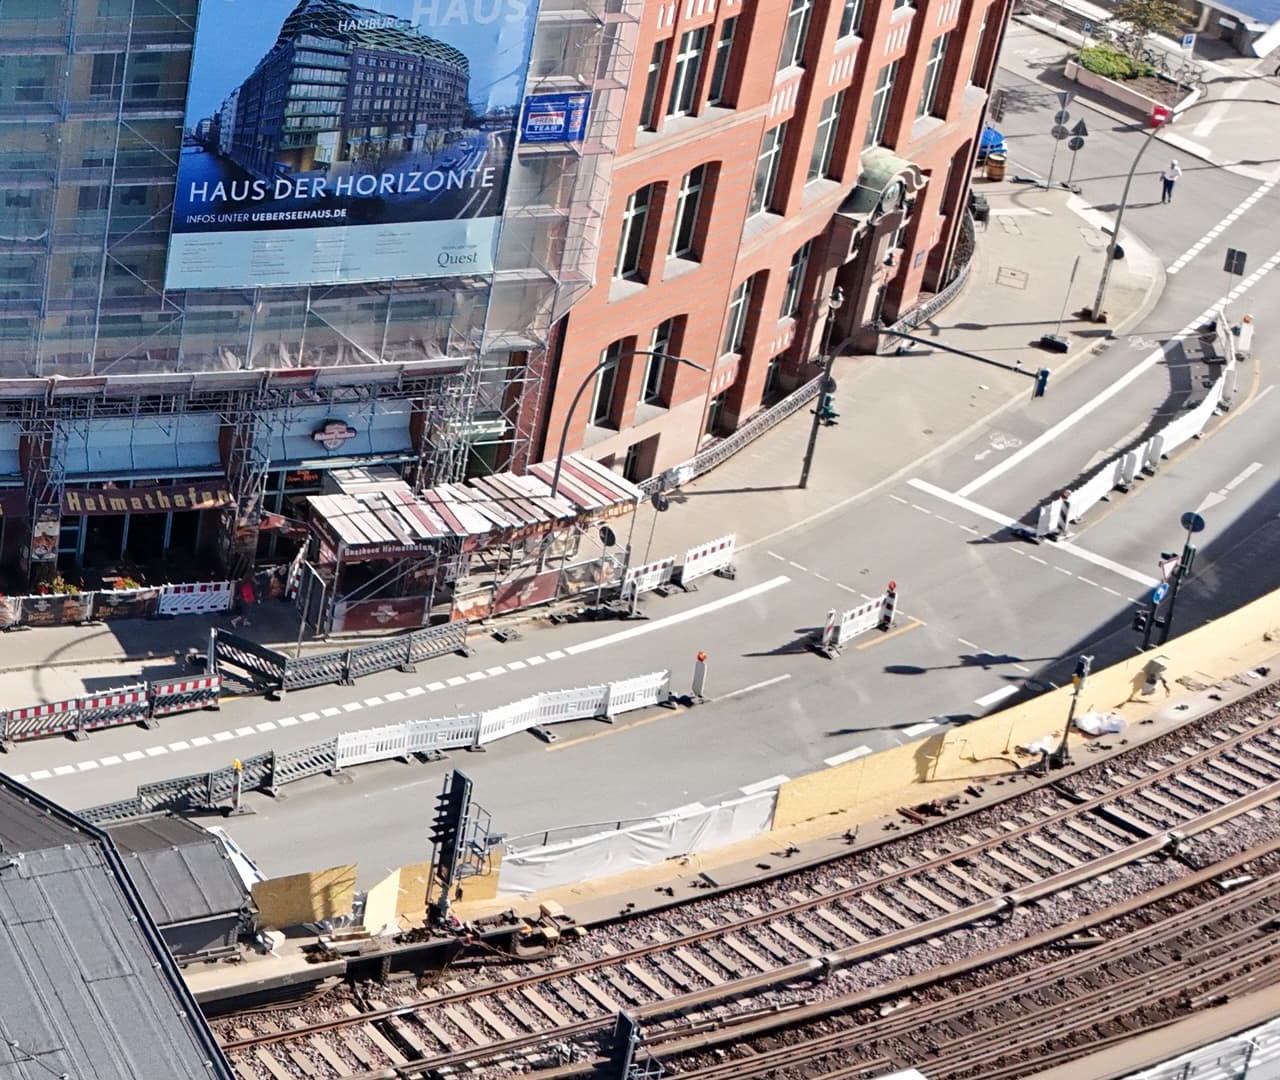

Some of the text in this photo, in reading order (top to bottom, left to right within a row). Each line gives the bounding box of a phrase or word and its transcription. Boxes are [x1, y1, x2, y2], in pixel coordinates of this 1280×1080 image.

[337, 16, 405, 32] HAMBURG
[189, 168, 495, 203] HAUS DER HORIZONTE
[186, 208, 347, 224] INFOS UNTER UEBERSEEHAUS.DE
[437, 251, 479, 268] Quest
[66, 487, 230, 512] Heimathafen
